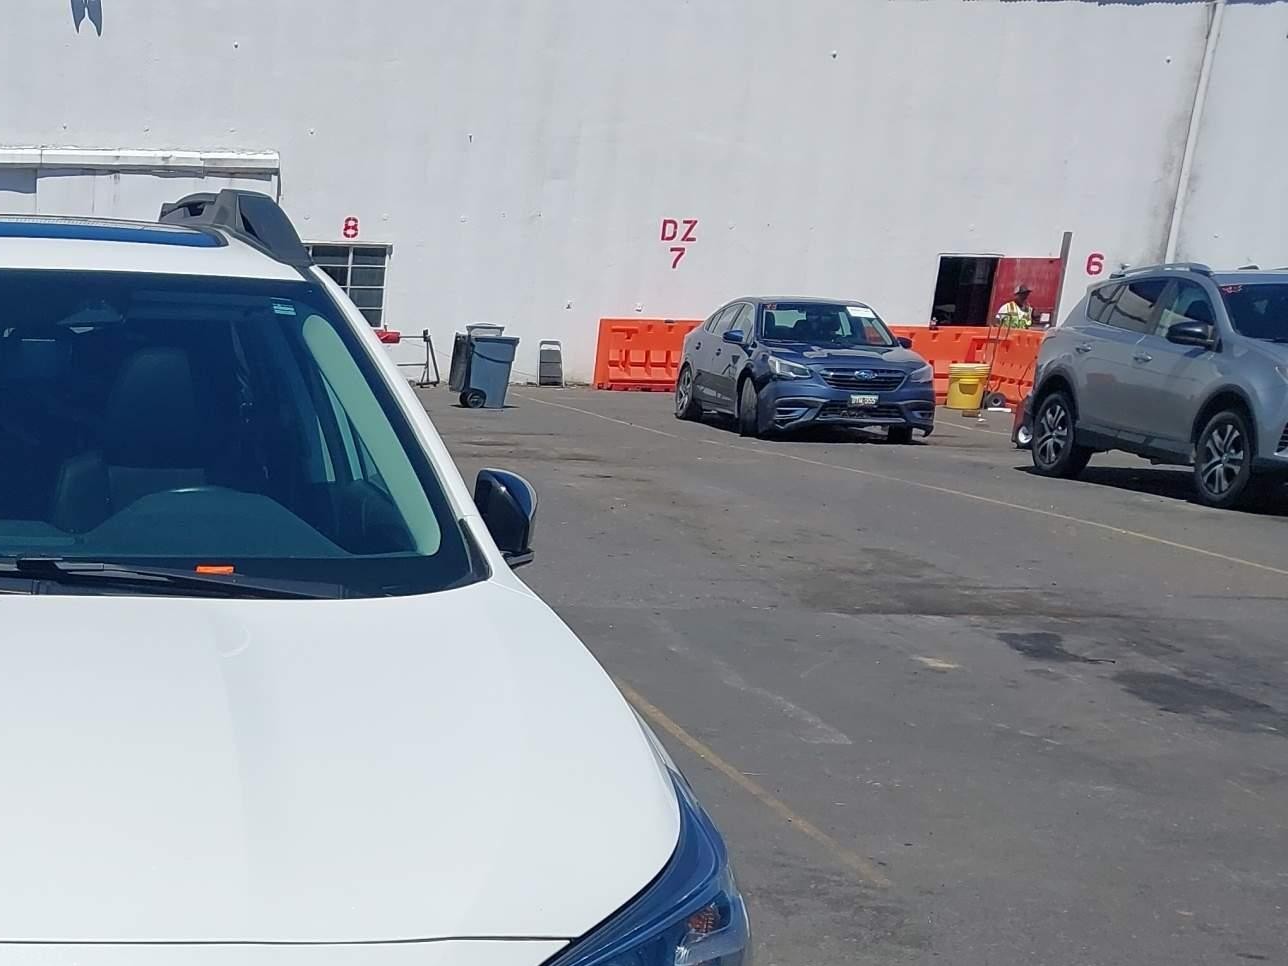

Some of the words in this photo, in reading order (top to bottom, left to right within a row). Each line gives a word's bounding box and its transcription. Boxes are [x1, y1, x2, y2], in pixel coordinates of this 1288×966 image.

[343, 216, 359, 238] 8
[661, 219, 698, 242] DZ
[669, 247, 686, 269] 7
[1086, 253, 1105, 276] 6
